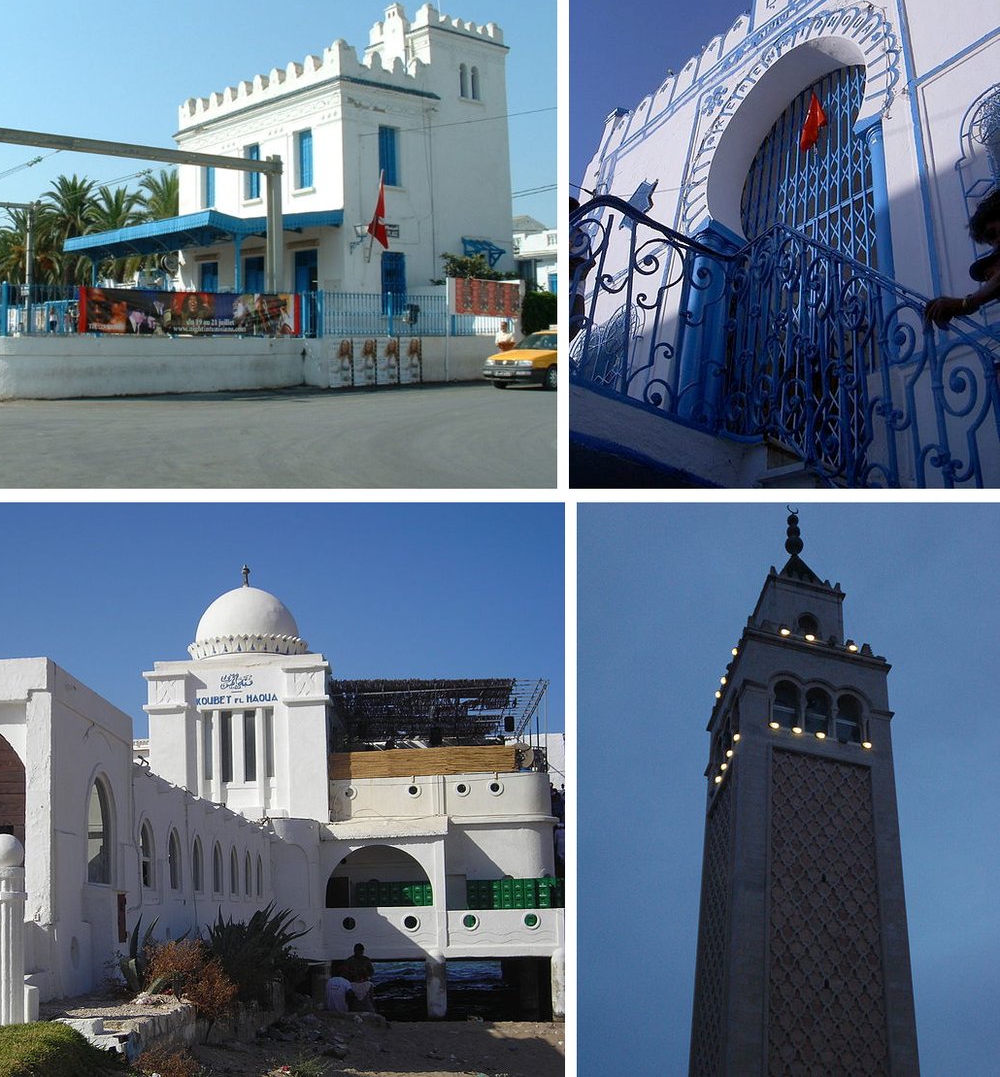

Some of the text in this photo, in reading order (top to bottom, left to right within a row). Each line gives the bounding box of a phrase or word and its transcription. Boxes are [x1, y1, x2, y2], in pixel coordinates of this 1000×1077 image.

[218, 319, 235, 328] juillet
[195, 695, 232, 706] KOUBET
[246, 693, 279, 703] HAOUA
